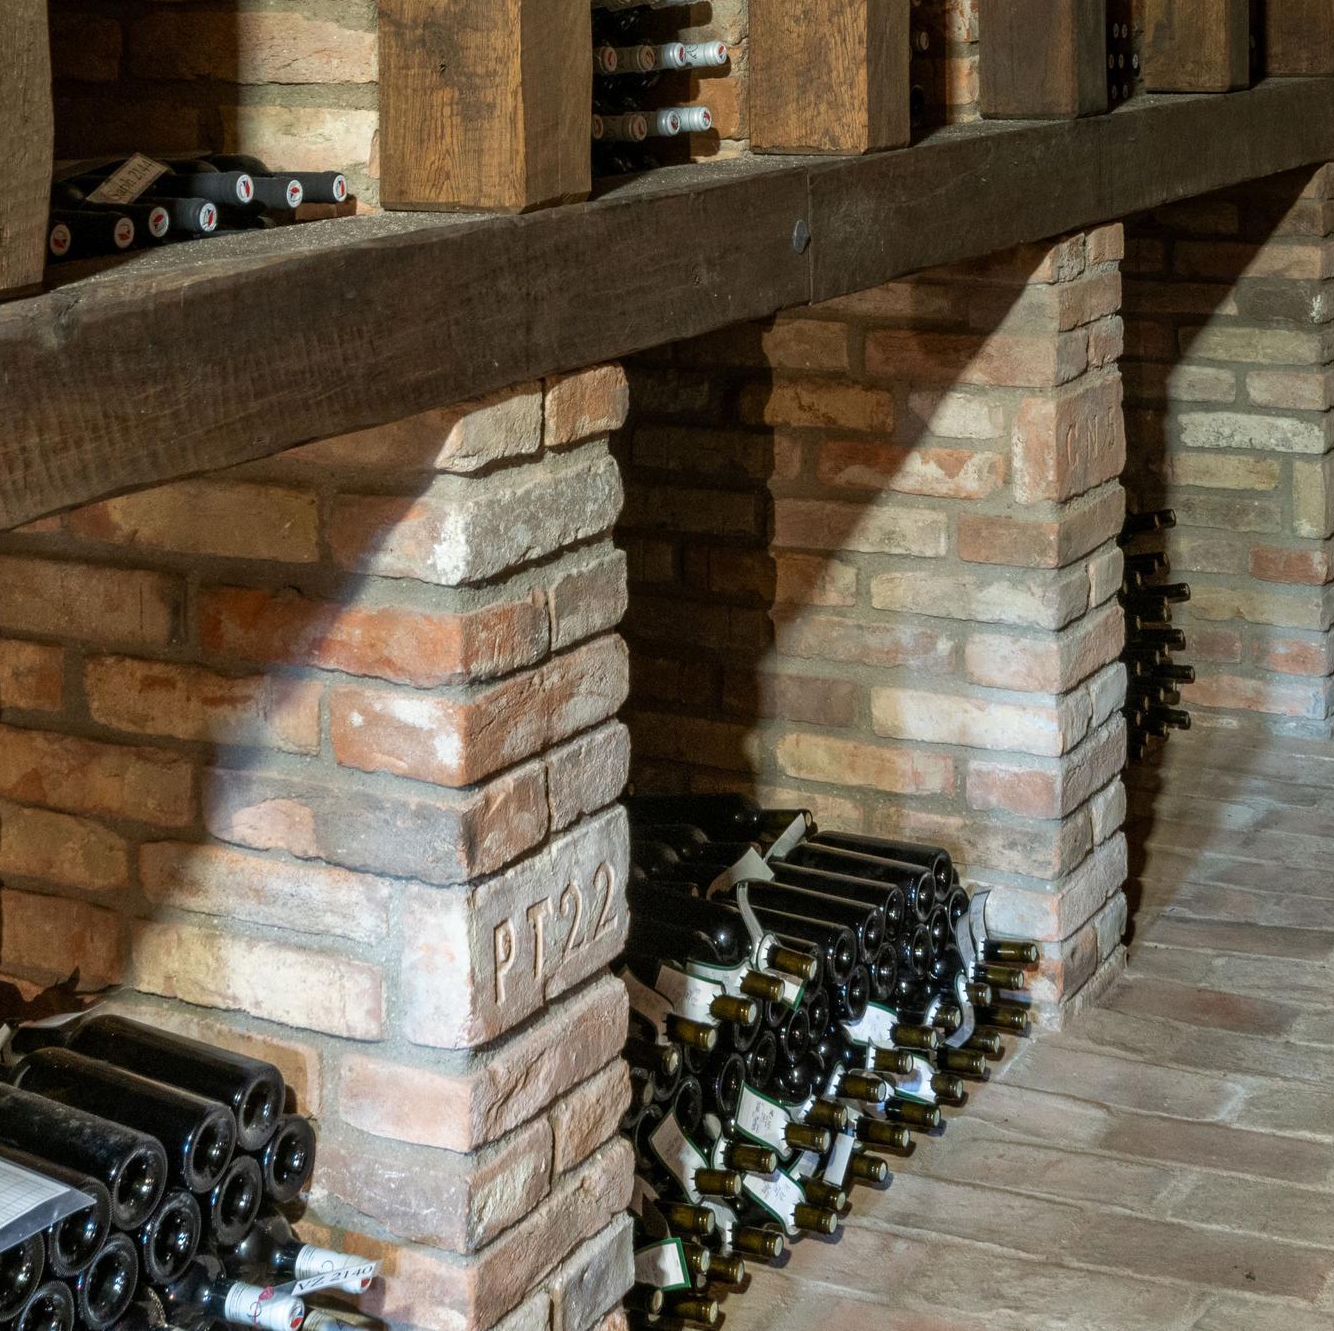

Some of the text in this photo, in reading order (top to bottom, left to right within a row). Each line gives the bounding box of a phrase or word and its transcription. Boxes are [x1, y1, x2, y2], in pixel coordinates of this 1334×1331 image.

[493, 860, 618, 1006] PT22
[297, 1265, 373, 1291] VZ 2140
